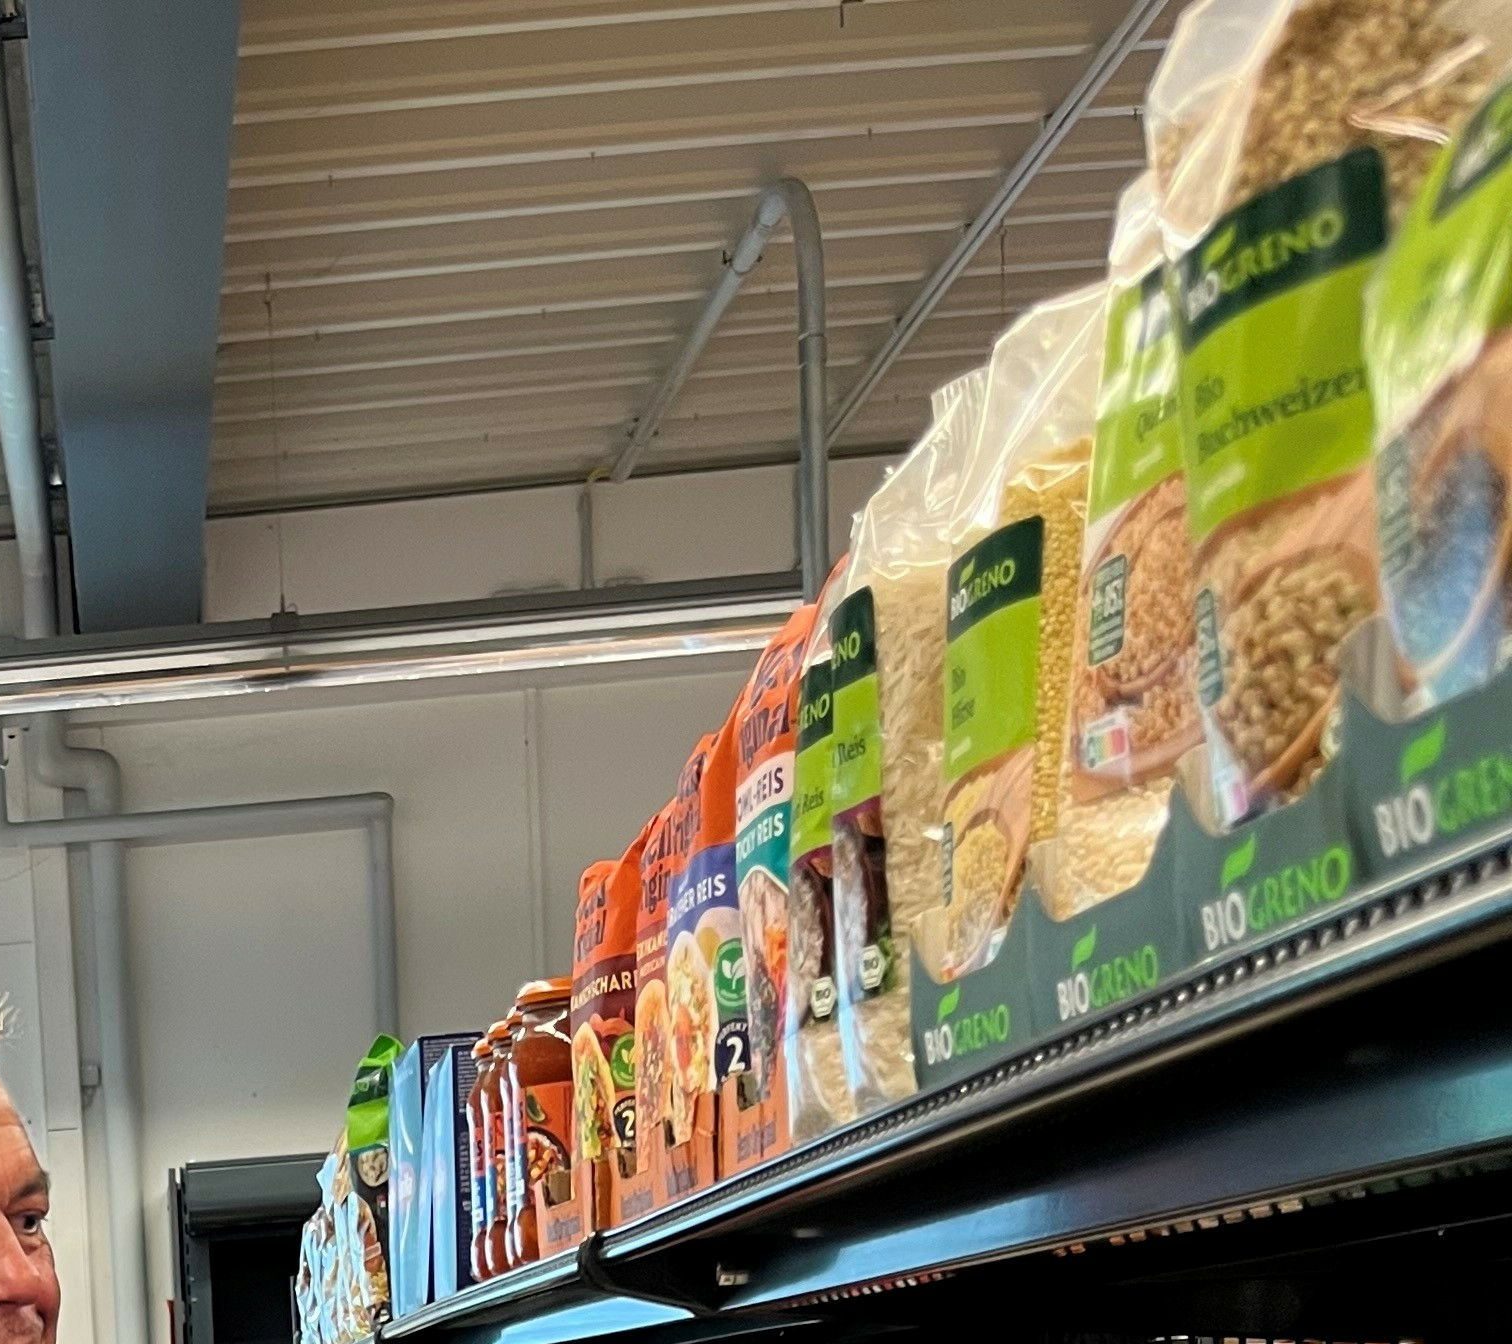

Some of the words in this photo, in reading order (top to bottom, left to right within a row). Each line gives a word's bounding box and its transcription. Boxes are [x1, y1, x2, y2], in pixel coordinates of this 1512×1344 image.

[1201, 844, 1351, 951] BIOGRENO
[1057, 945, 1158, 1021] BIOGRENO
[725, 1036, 746, 1074] 2
[925, 1004, 1009, 1065] BIOGRENO
[621, 1109, 635, 1138] 2
